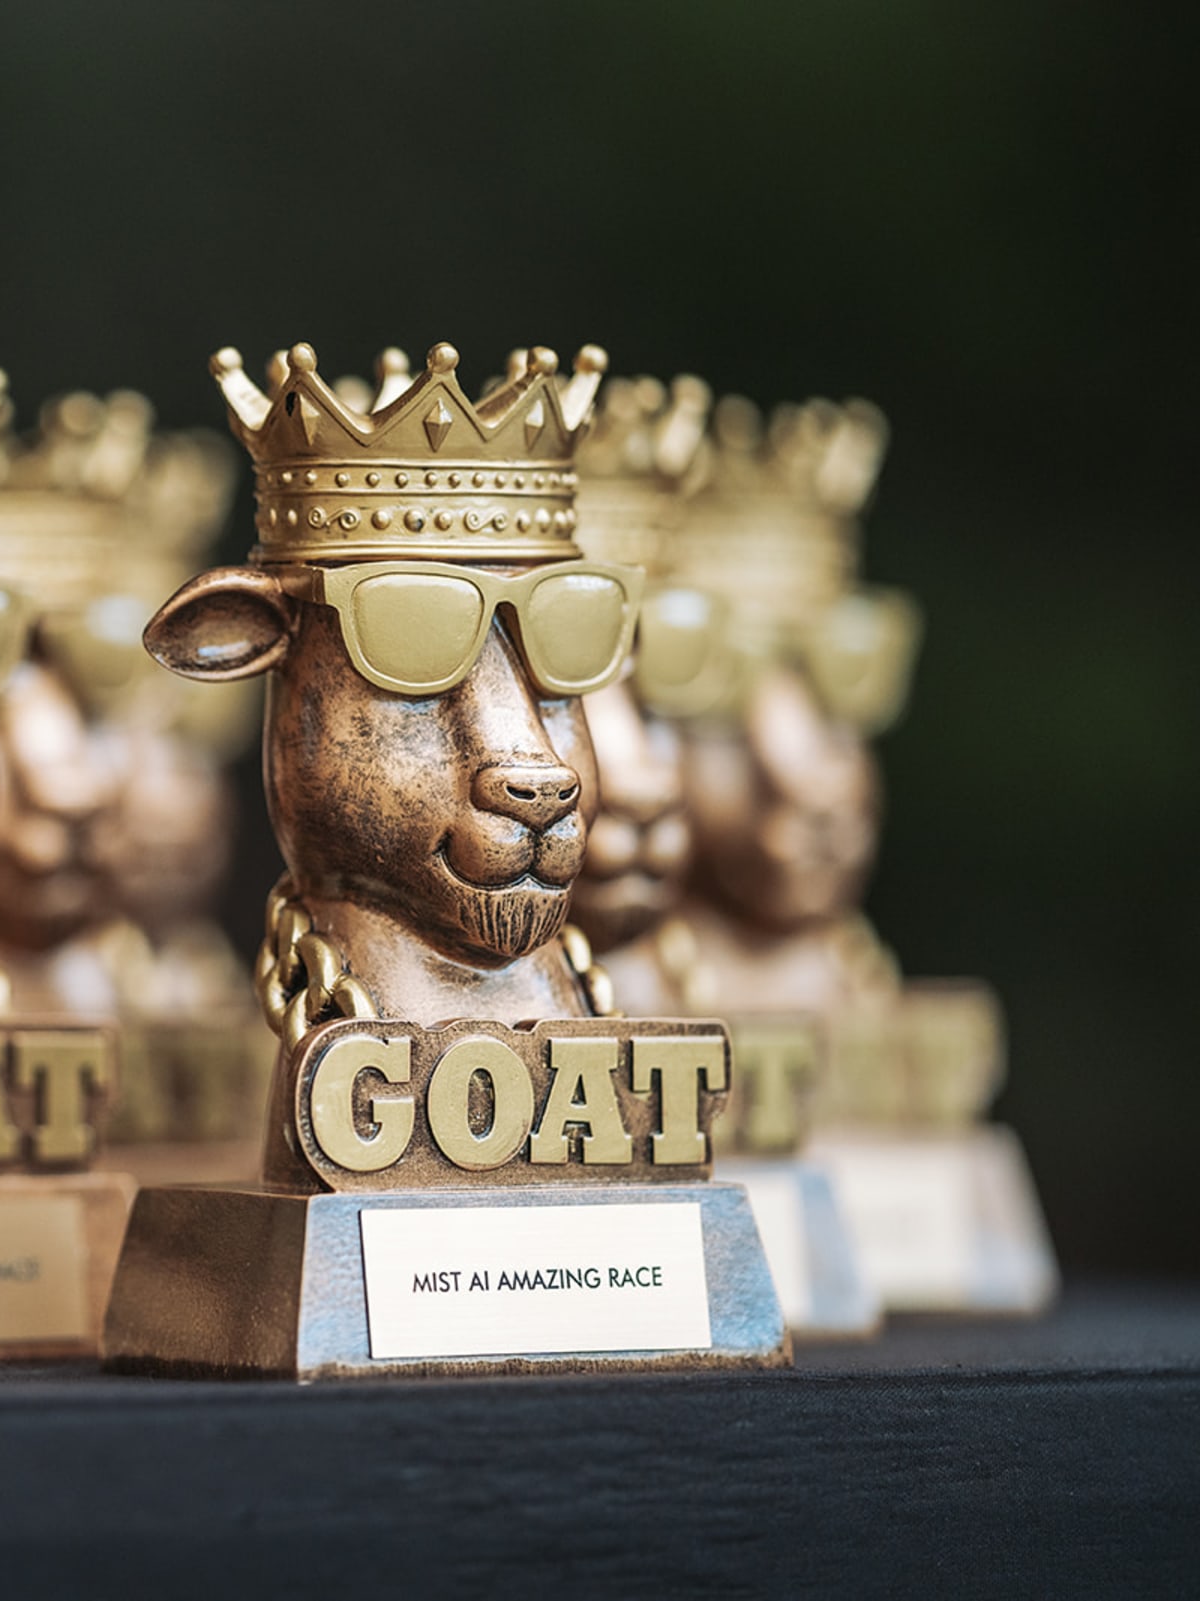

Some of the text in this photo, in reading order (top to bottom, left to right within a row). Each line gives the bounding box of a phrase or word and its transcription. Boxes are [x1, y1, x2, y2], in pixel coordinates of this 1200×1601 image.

[310, 1034, 727, 1172] GOAT
[412, 1266, 662, 1293] MIST AI AMAZING RACE
